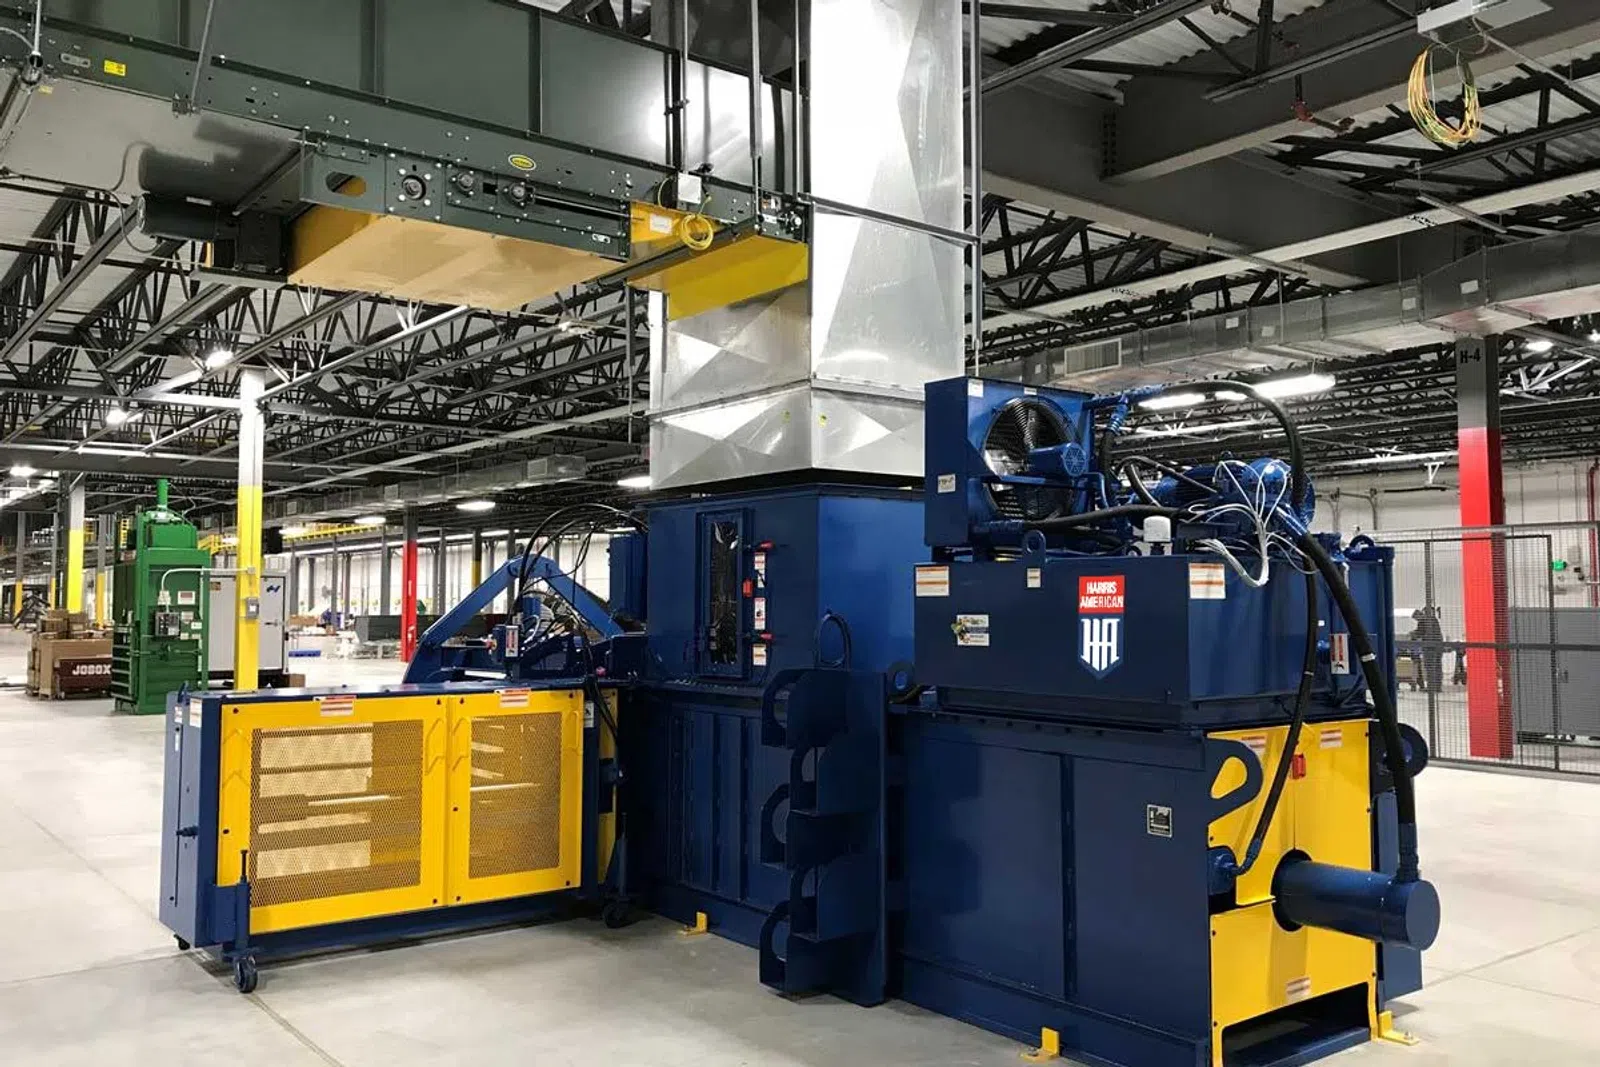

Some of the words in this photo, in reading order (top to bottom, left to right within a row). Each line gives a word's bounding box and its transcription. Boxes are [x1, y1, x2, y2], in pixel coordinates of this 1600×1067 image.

[1460, 348, 1481, 363] H-4
[1086, 582, 1118, 595] HARRIS
[1080, 596, 1124, 608] AMERICAN
[72, 664, 112, 675] JOBOX
